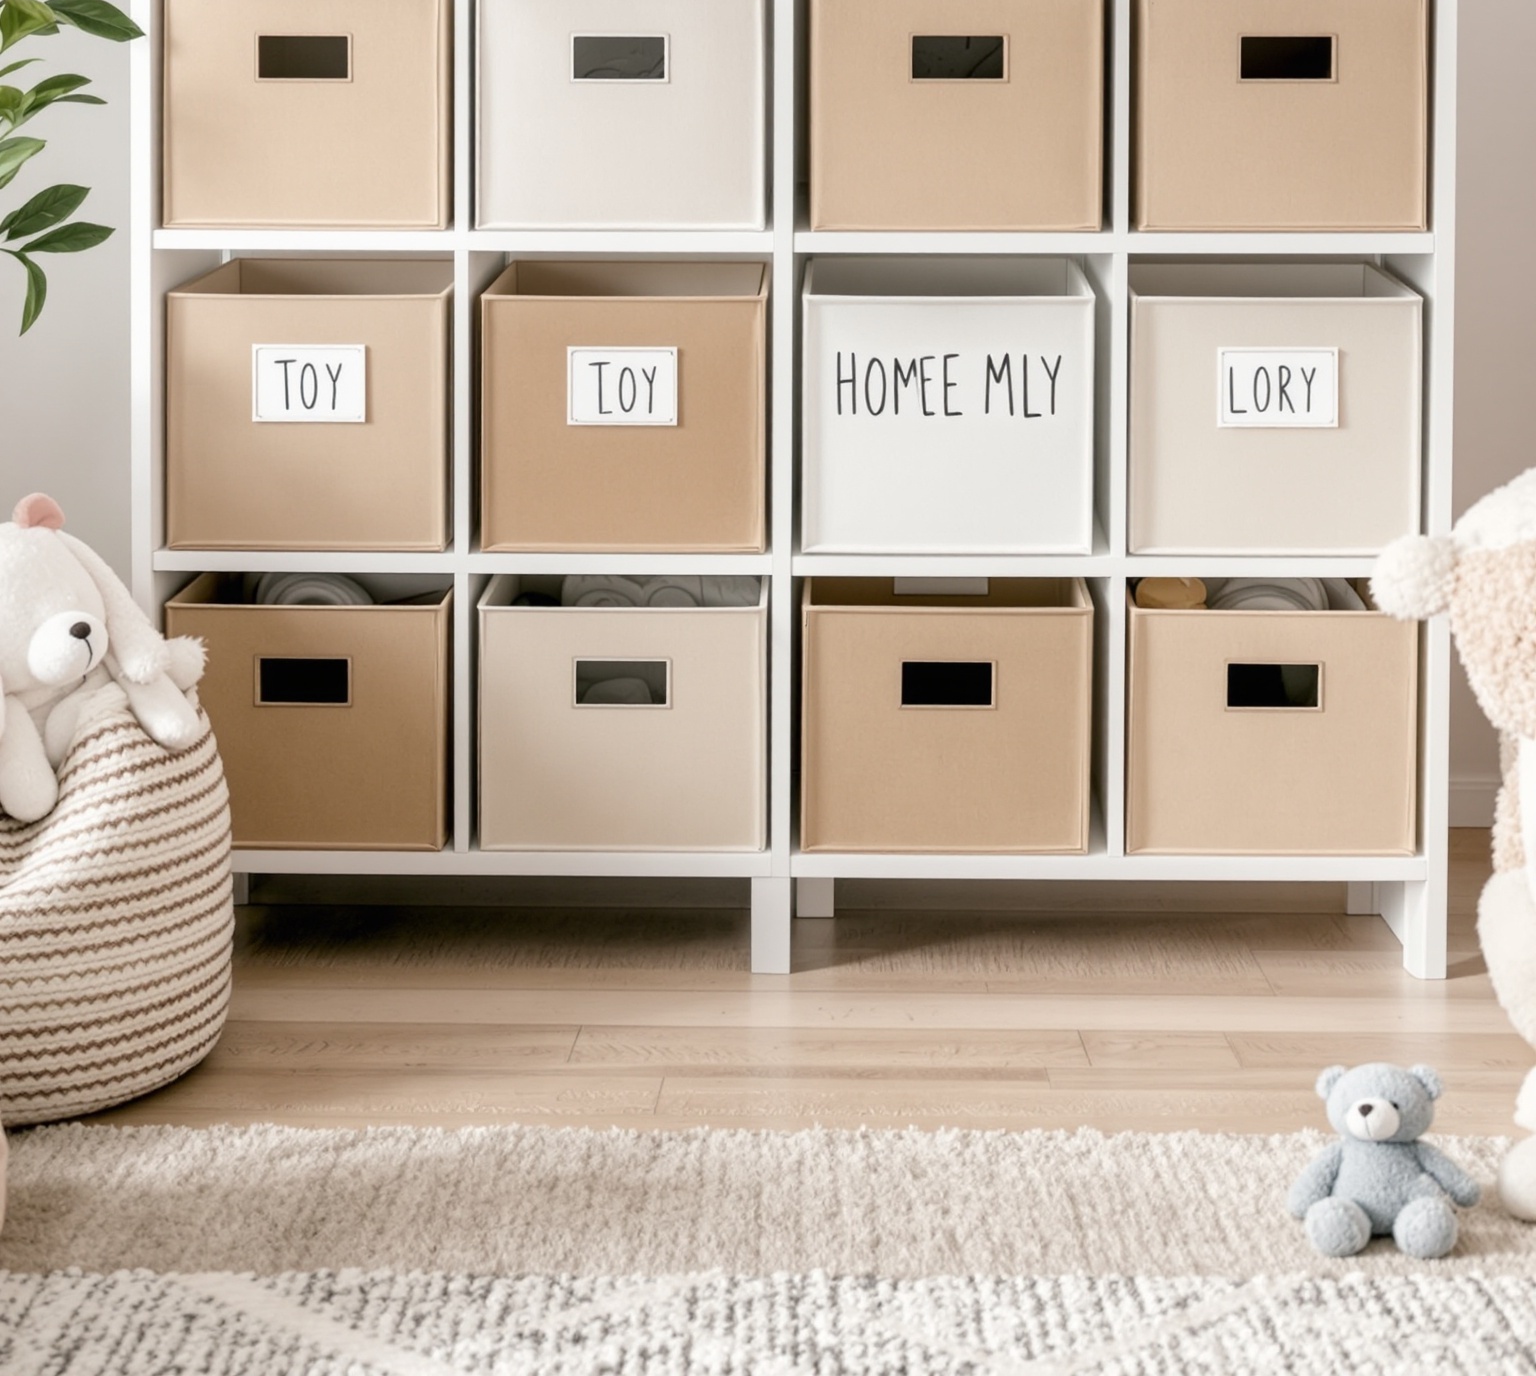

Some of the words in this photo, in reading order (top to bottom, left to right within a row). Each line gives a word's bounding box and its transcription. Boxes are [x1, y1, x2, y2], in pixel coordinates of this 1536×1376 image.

[274, 359, 343, 411] TOY
[836, 351, 963, 417] HOMEE
[985, 353, 1062, 418] MLY
[1229, 365, 1317, 414] LORY
